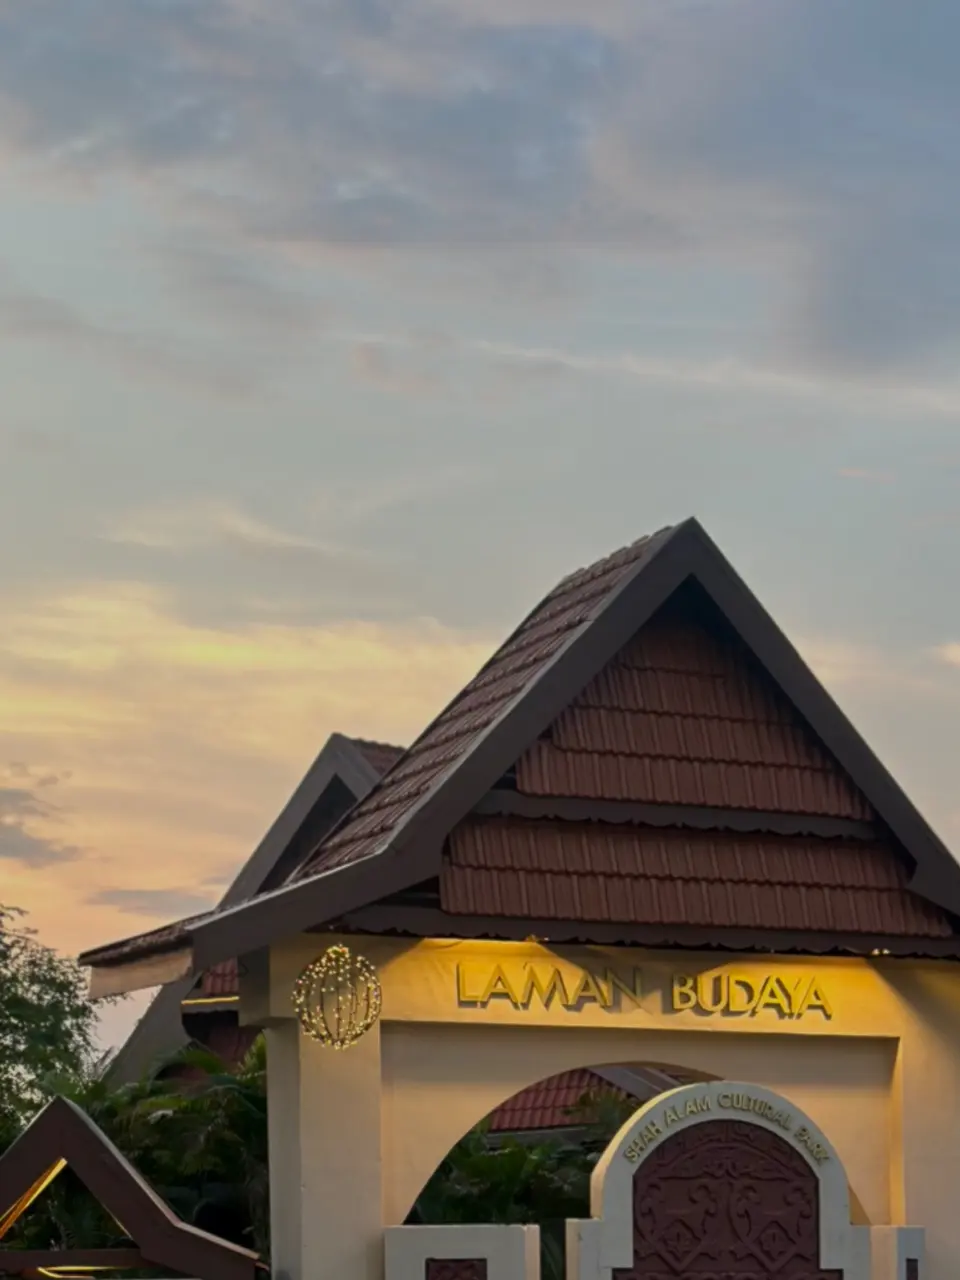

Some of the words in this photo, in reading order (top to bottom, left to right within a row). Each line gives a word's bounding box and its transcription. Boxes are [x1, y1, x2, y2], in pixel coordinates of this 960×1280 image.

[458, 962, 645, 1011] LAMAN
[671, 973, 833, 1018] BUDAYA
[624, 1120, 663, 1162] SHAH
[663, 1096, 712, 1128] ALAM
[717, 1093, 794, 1131] CULTURAL
[793, 1121, 829, 1166] PARK
